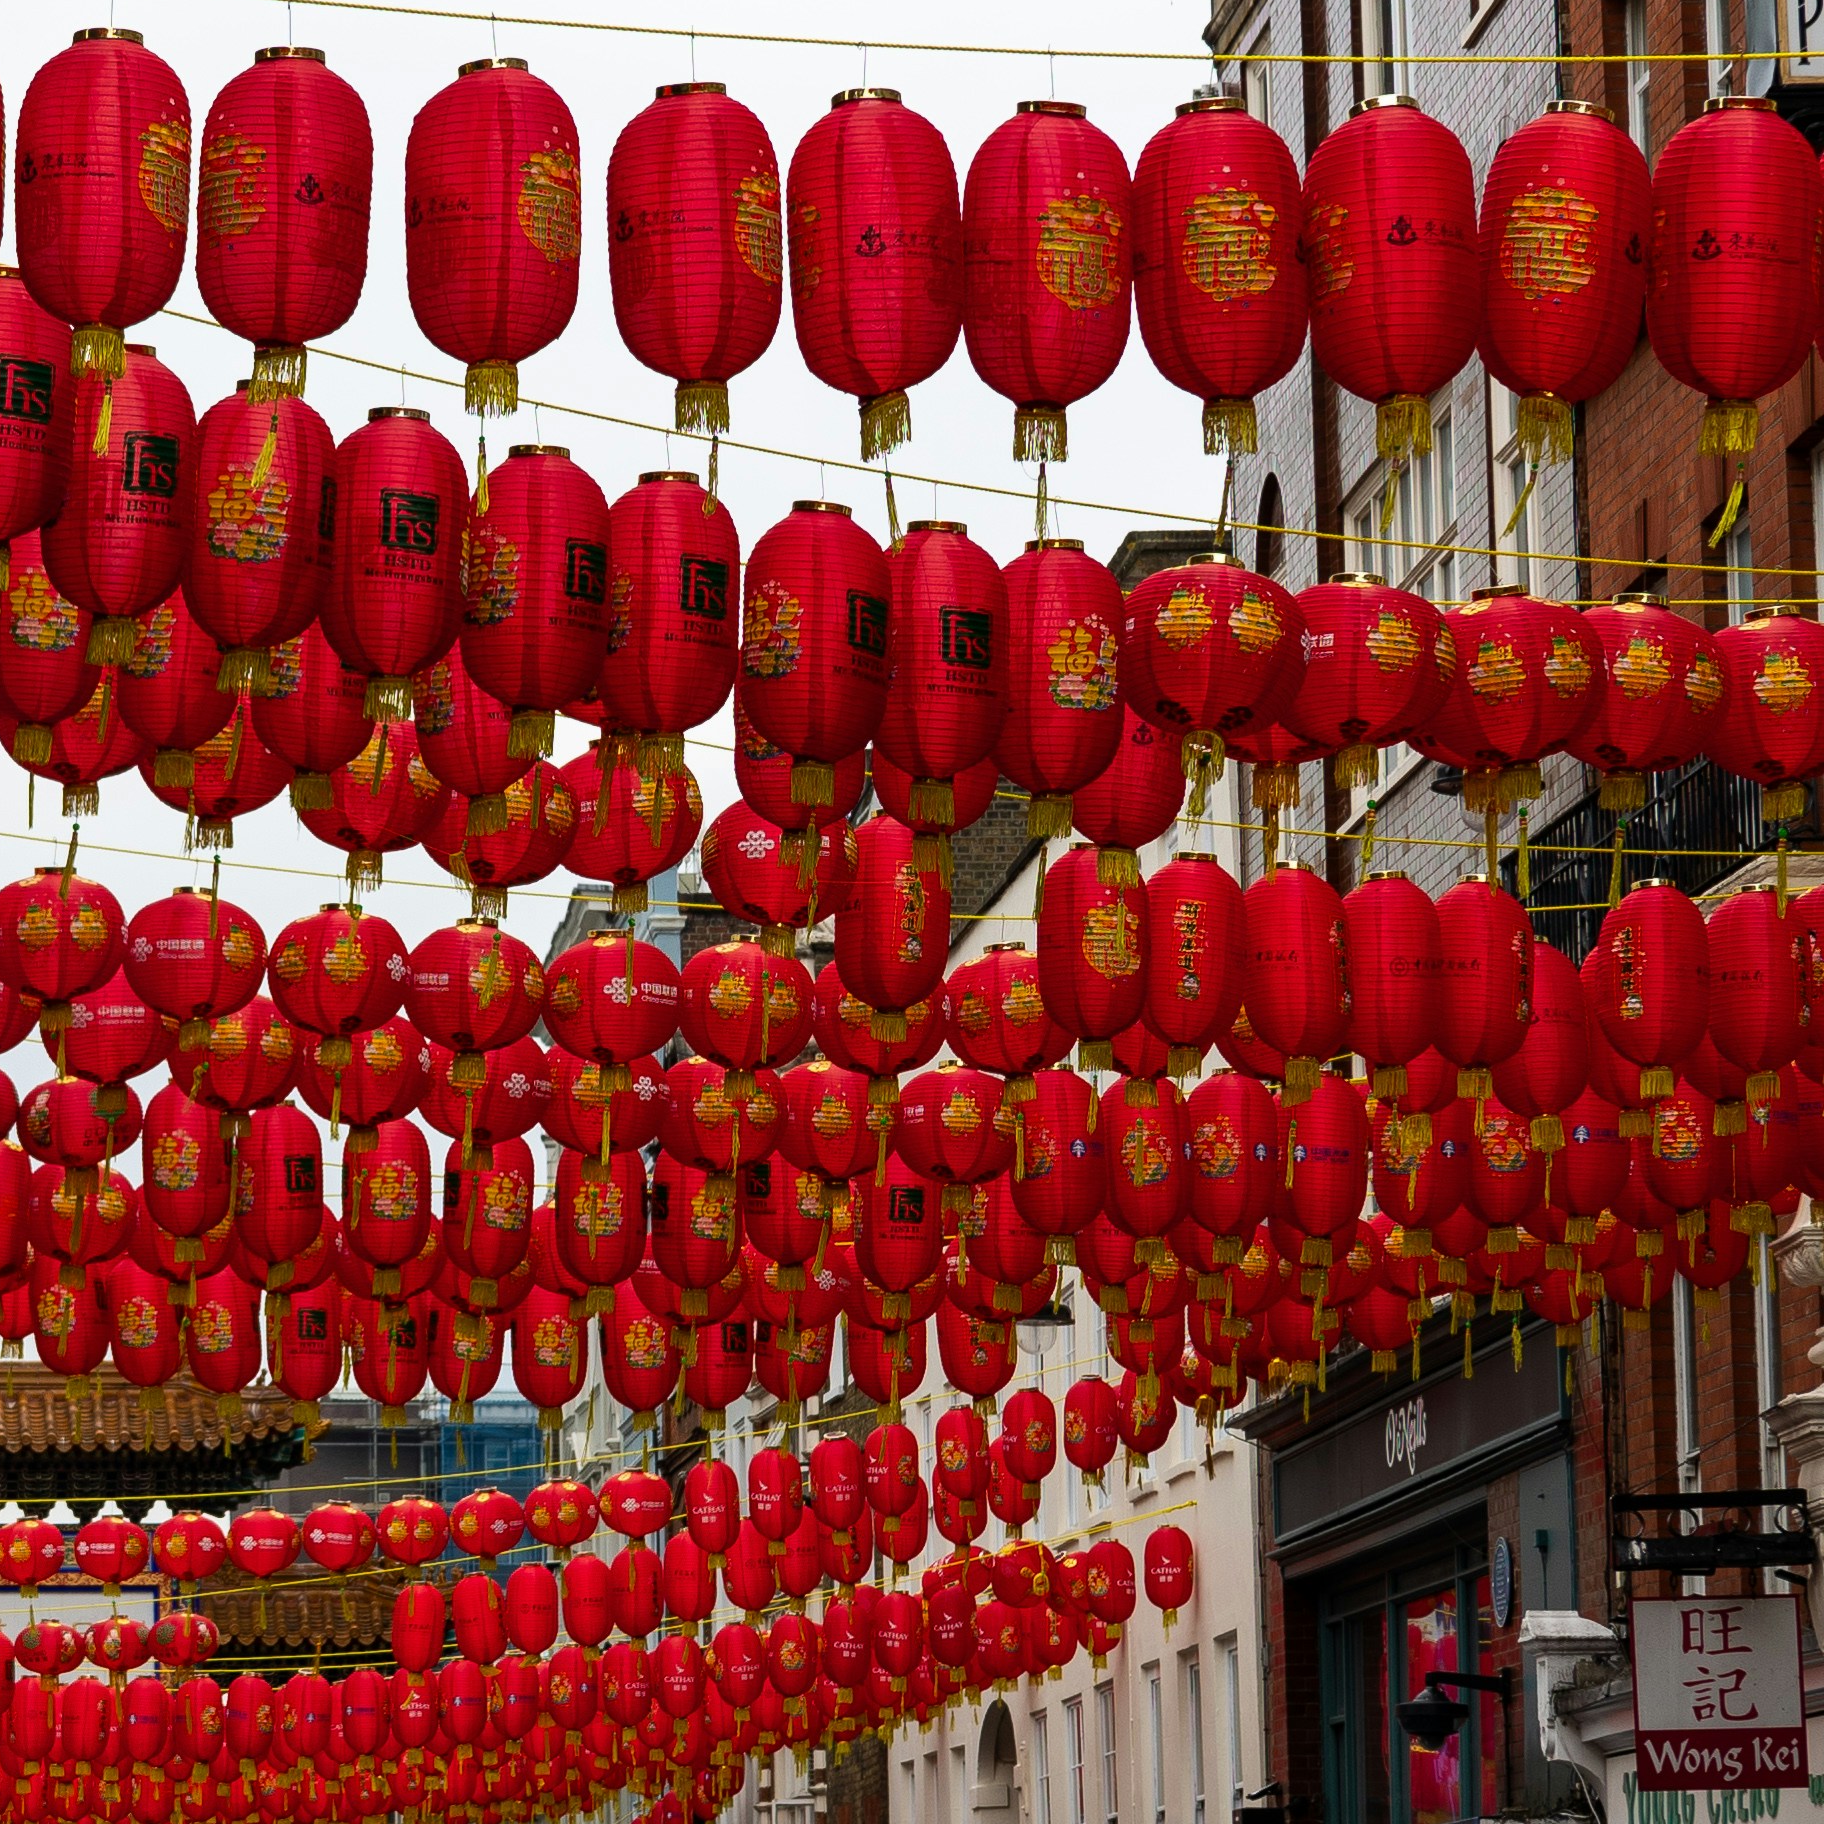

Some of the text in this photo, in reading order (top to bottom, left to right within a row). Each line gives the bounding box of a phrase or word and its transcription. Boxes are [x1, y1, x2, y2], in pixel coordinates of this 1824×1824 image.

[1680, 1605, 1759, 1722] 旺記
[1643, 1736, 1801, 1782] Wong Kei
